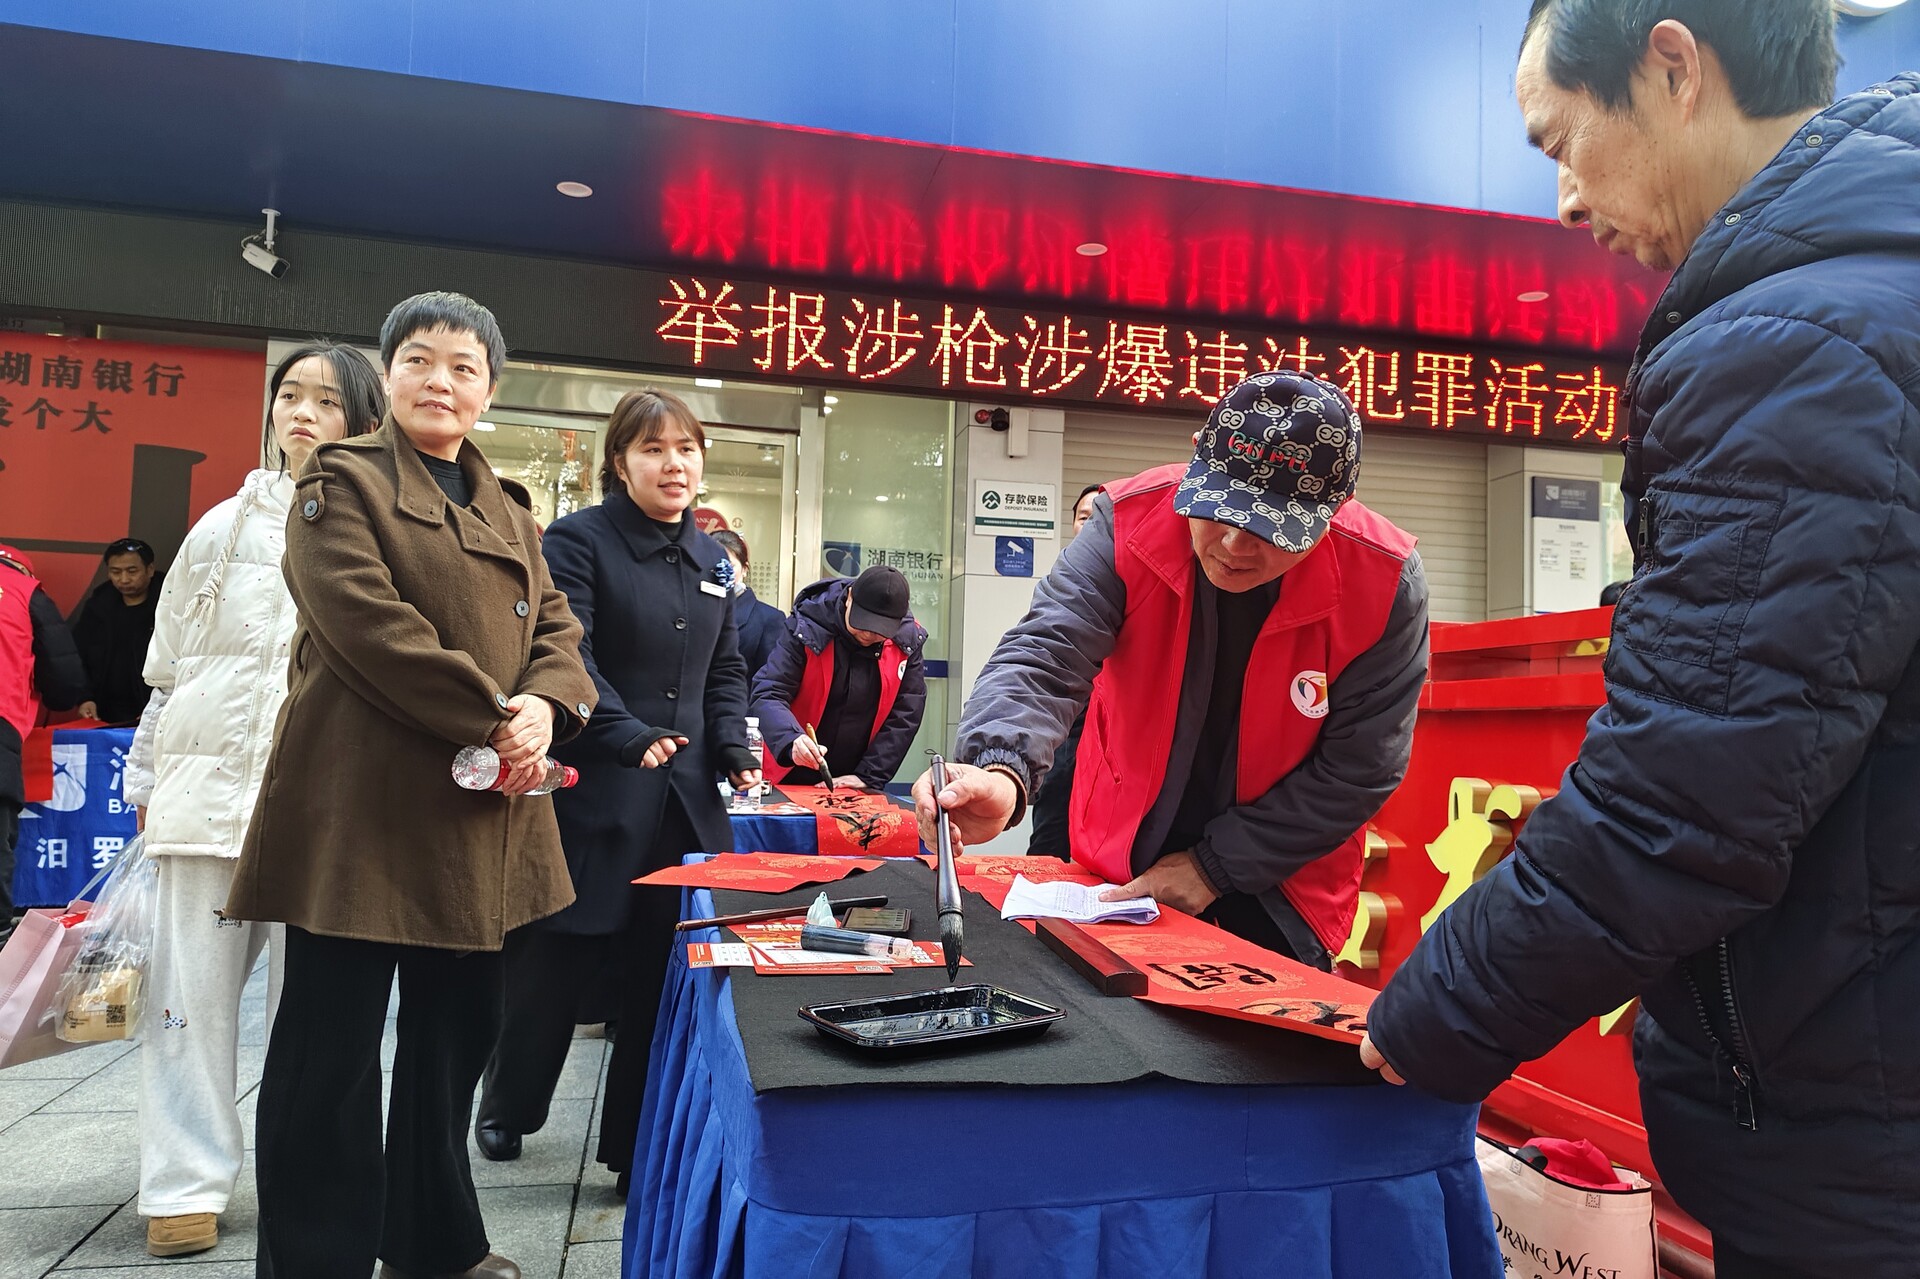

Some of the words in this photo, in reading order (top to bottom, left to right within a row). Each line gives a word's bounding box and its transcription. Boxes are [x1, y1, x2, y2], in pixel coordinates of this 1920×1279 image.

[0, 351, 187, 397] 湖南银行
[1004, 493, 1048, 507] 存款保险
[867, 549, 944, 571] 湖南银行
